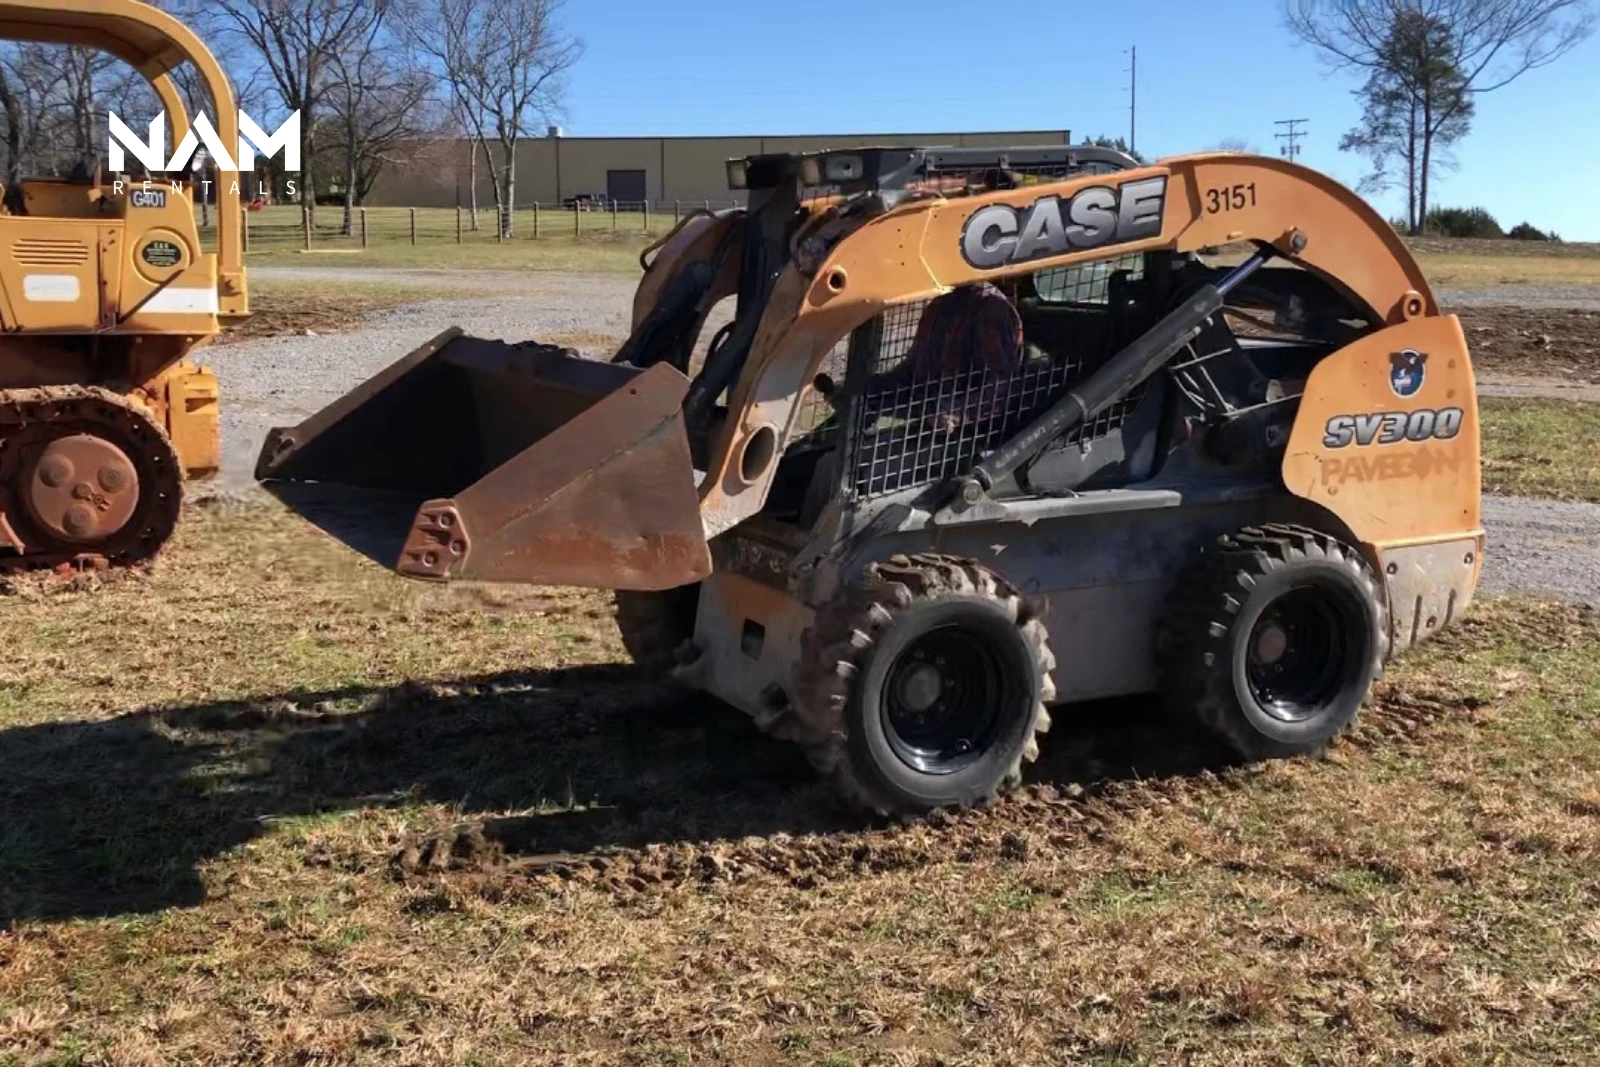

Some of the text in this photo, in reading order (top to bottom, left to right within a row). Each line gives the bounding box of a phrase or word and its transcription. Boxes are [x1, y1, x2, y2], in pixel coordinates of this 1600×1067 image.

[132, 190, 164, 207] G401
[1205, 182, 1257, 214] 3151
[962, 175, 1166, 268] CASE
[1322, 407, 1464, 449] SV300
